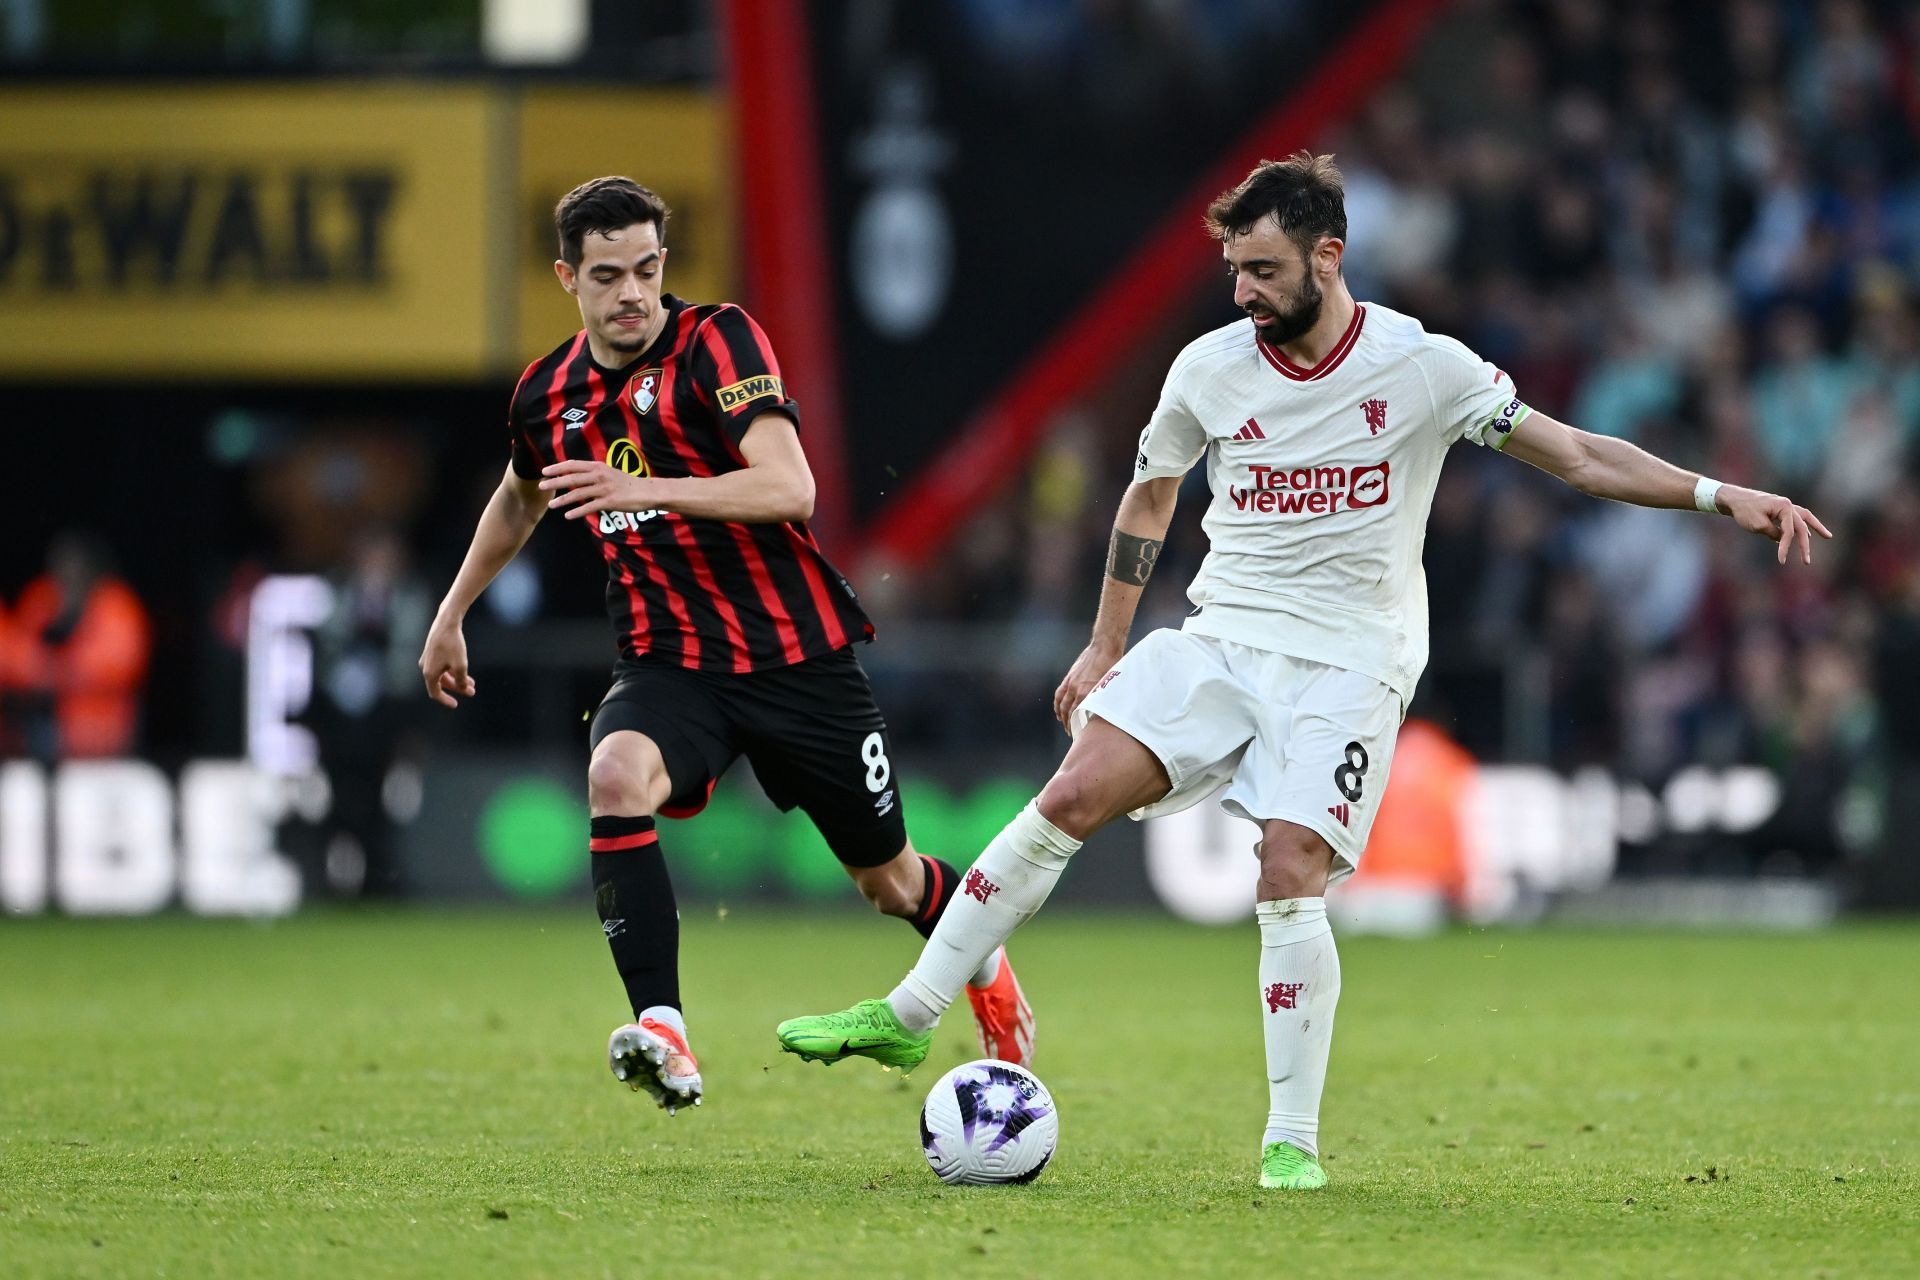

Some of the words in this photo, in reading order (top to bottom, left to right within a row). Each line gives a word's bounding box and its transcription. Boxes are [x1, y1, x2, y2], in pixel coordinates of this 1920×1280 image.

[1248, 466, 1346, 490] Team
[861, 732, 890, 793] 8
[1334, 741, 1369, 802] 8
